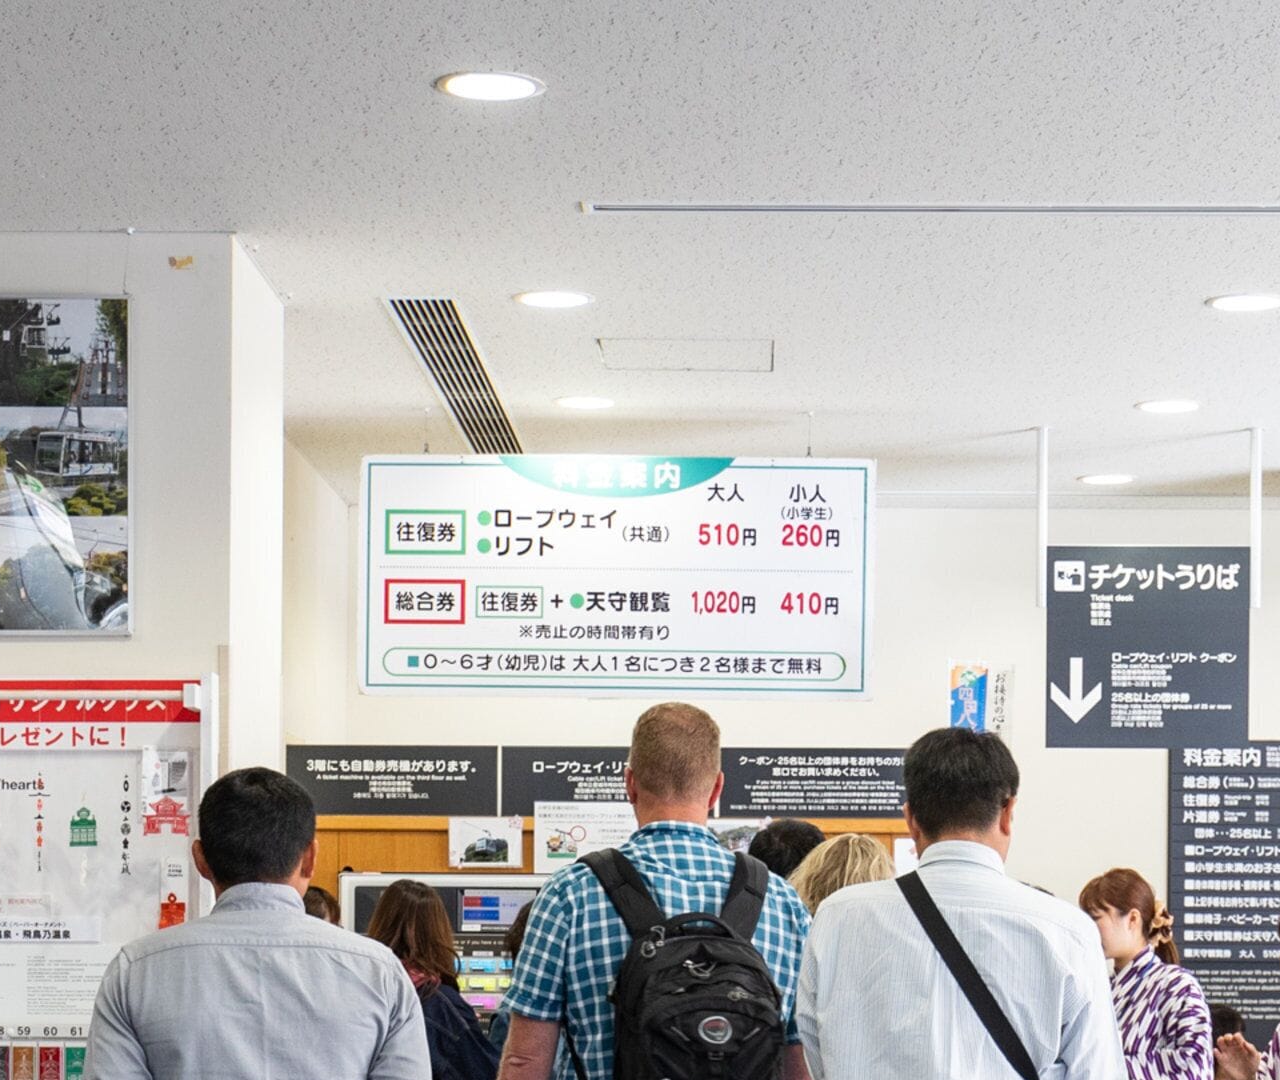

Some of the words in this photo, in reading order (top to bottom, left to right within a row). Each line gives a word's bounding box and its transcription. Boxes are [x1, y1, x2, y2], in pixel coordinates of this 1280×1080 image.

[707, 484, 745, 502] 大人
[789, 485, 827, 503] 小人
[494, 508, 618, 530] ロープウェイ
[780, 506, 834, 521] (小学生)
[395, 522, 456, 543] 往復券
[622, 525, 672, 544] (共通)
[698, 523, 758, 547] 510円
[781, 524, 841, 548] 260円
[494, 536, 555, 557] リフト
[1088, 562, 1241, 591] チケットうりば
[395, 591, 456, 612] 総合券
[480, 591, 539, 611] 往復券
[585, 591, 672, 613] 天守観覧
[691, 590, 756, 614] 1,020円
[780, 591, 840, 615] 410円
[519, 624, 671, 641] ※売止の時間帯有り
[572, 655, 823, 675] 大人1名につき2名様まで無料
[1112, 652, 1197, 664] ロープウェイ・リフト
[1200, 652, 1237, 664] クーポン
[306, 759, 477, 774] 3階にも自動券売機があります。
[1183, 748, 1261, 767] 料金案内
[1183, 776, 1220, 789] 総合券
[17, 1026, 31, 1036] 59
[43, 1026, 58, 1036] 60
[70, 1026, 84, 1036] 61
